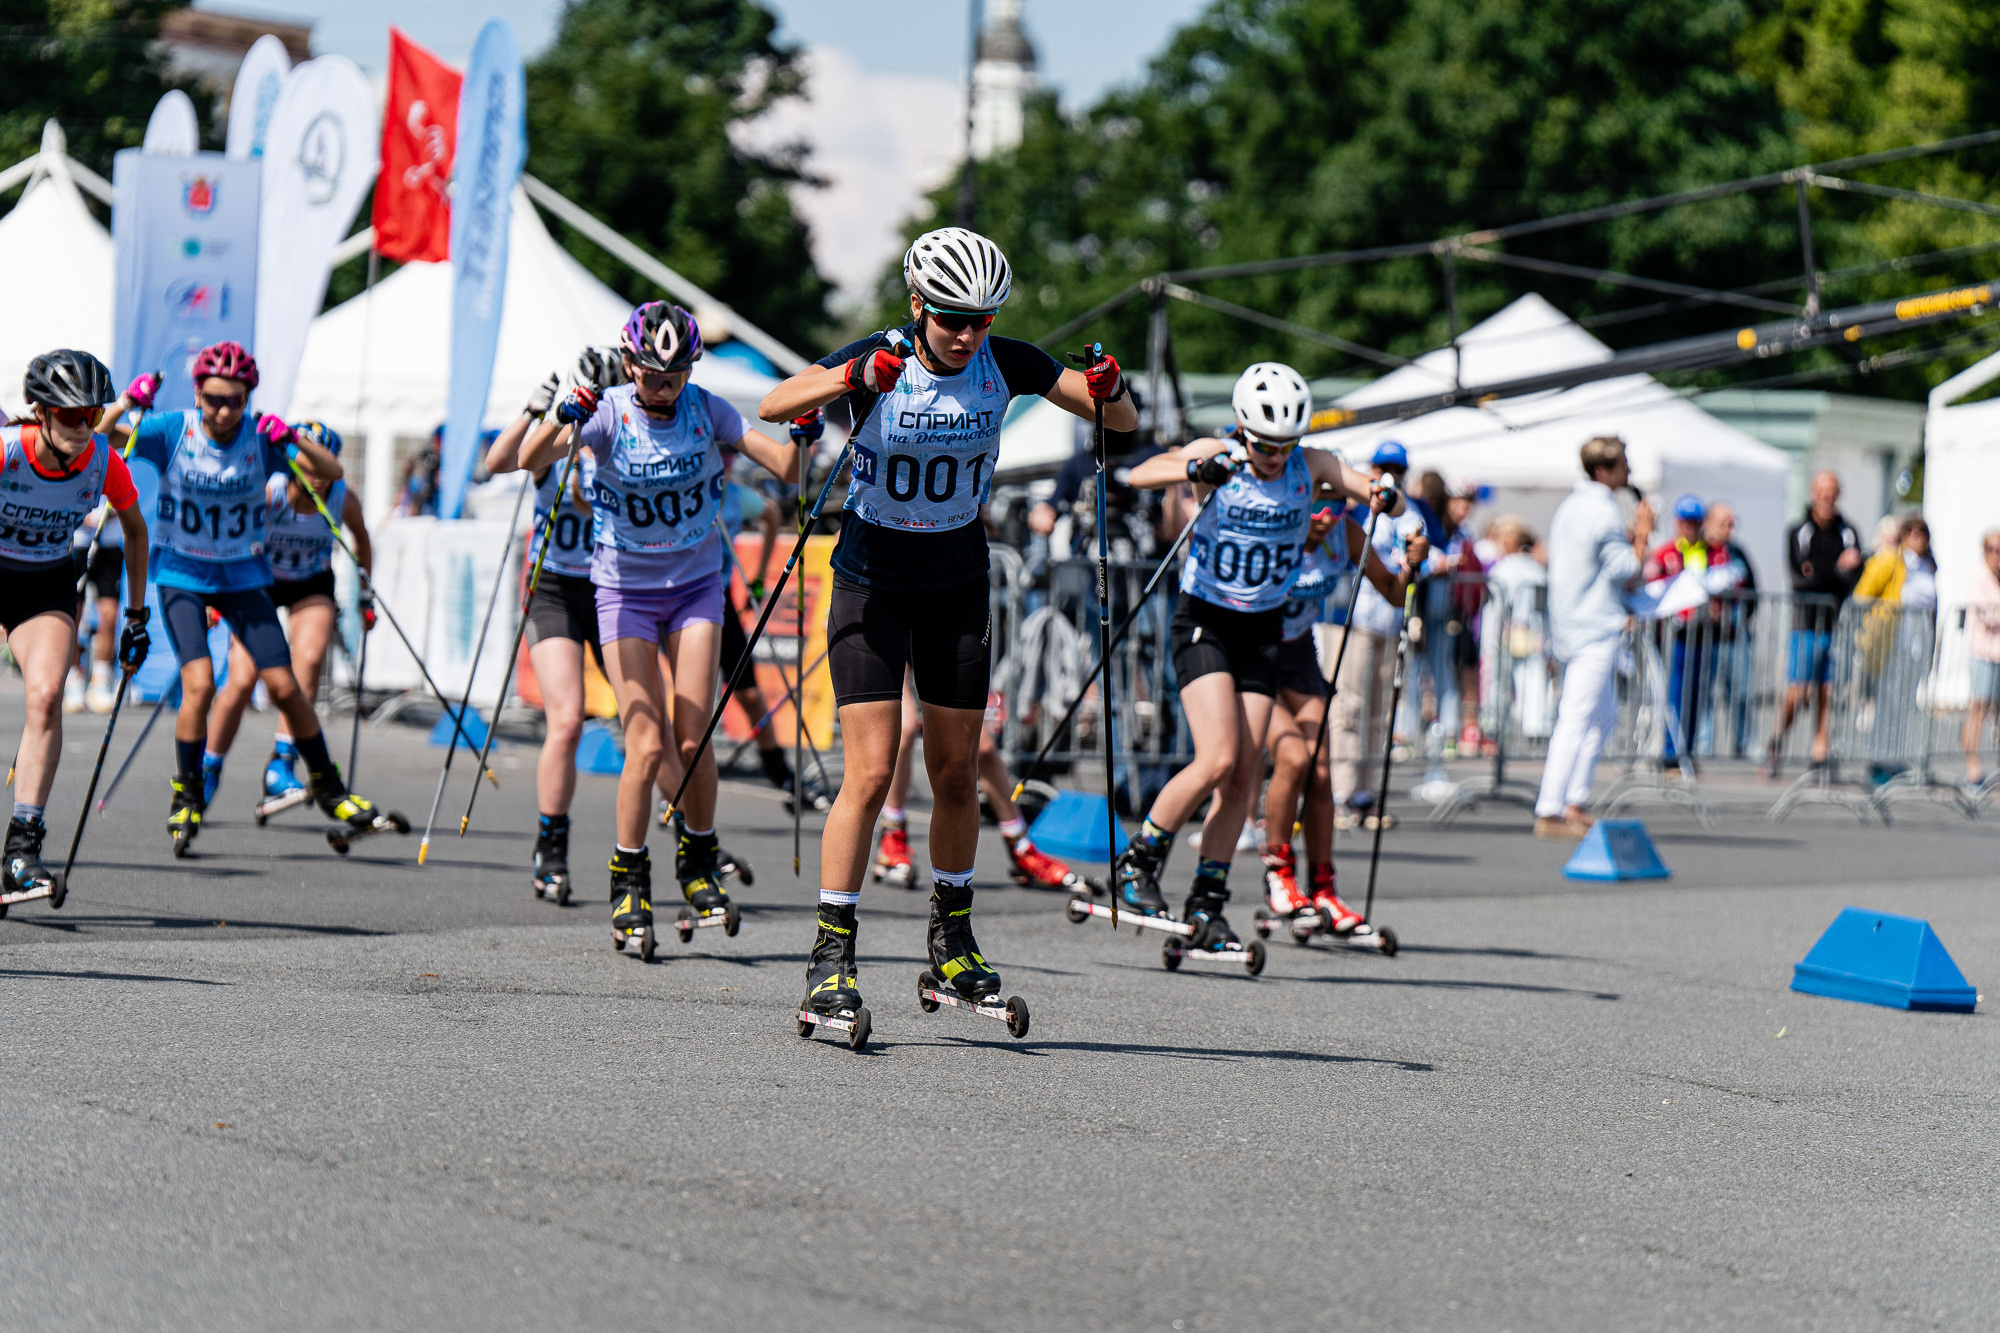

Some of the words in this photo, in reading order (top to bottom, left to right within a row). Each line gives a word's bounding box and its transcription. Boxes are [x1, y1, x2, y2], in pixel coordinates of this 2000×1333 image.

[899, 411, 993, 429] СПРИНТ
[887, 433, 909, 444] на
[629, 451, 705, 477] СПРИНТ
[886, 452, 988, 503] 001
[2, 502, 83, 523] СПРИНТ
[625, 481, 704, 528] 003
[181, 501, 247, 540] 013
[1215, 541, 1294, 587] 005
[818, 918, 851, 935] SCHER
